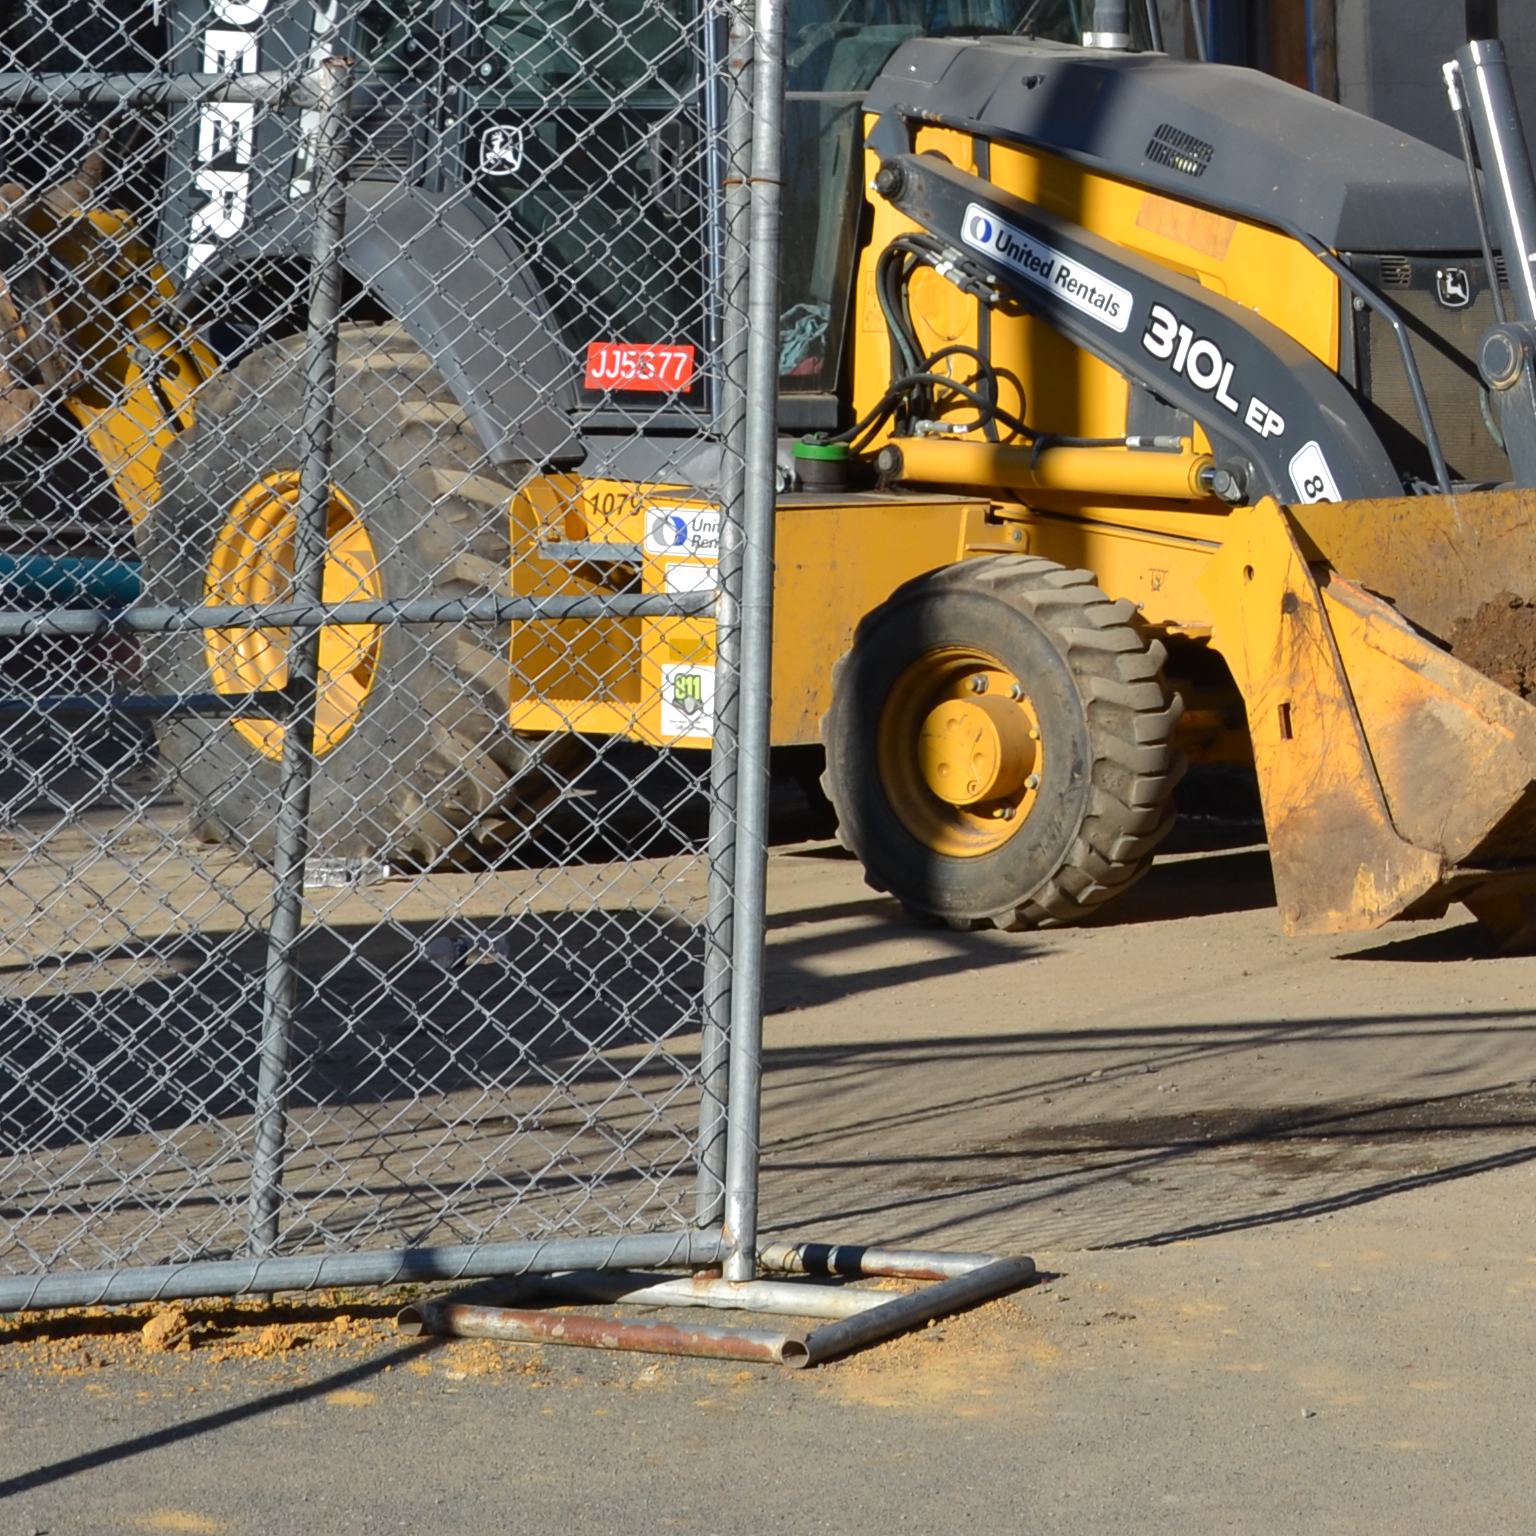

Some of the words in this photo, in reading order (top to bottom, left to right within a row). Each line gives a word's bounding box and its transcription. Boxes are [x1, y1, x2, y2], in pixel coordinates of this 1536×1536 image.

[995, 230, 1055, 279] United
[1054, 264, 1121, 318] Rentals
[1142, 303, 1240, 414] 310L
[1244, 396, 1286, 440] EP
[692, 535, 720, 549] Ren
